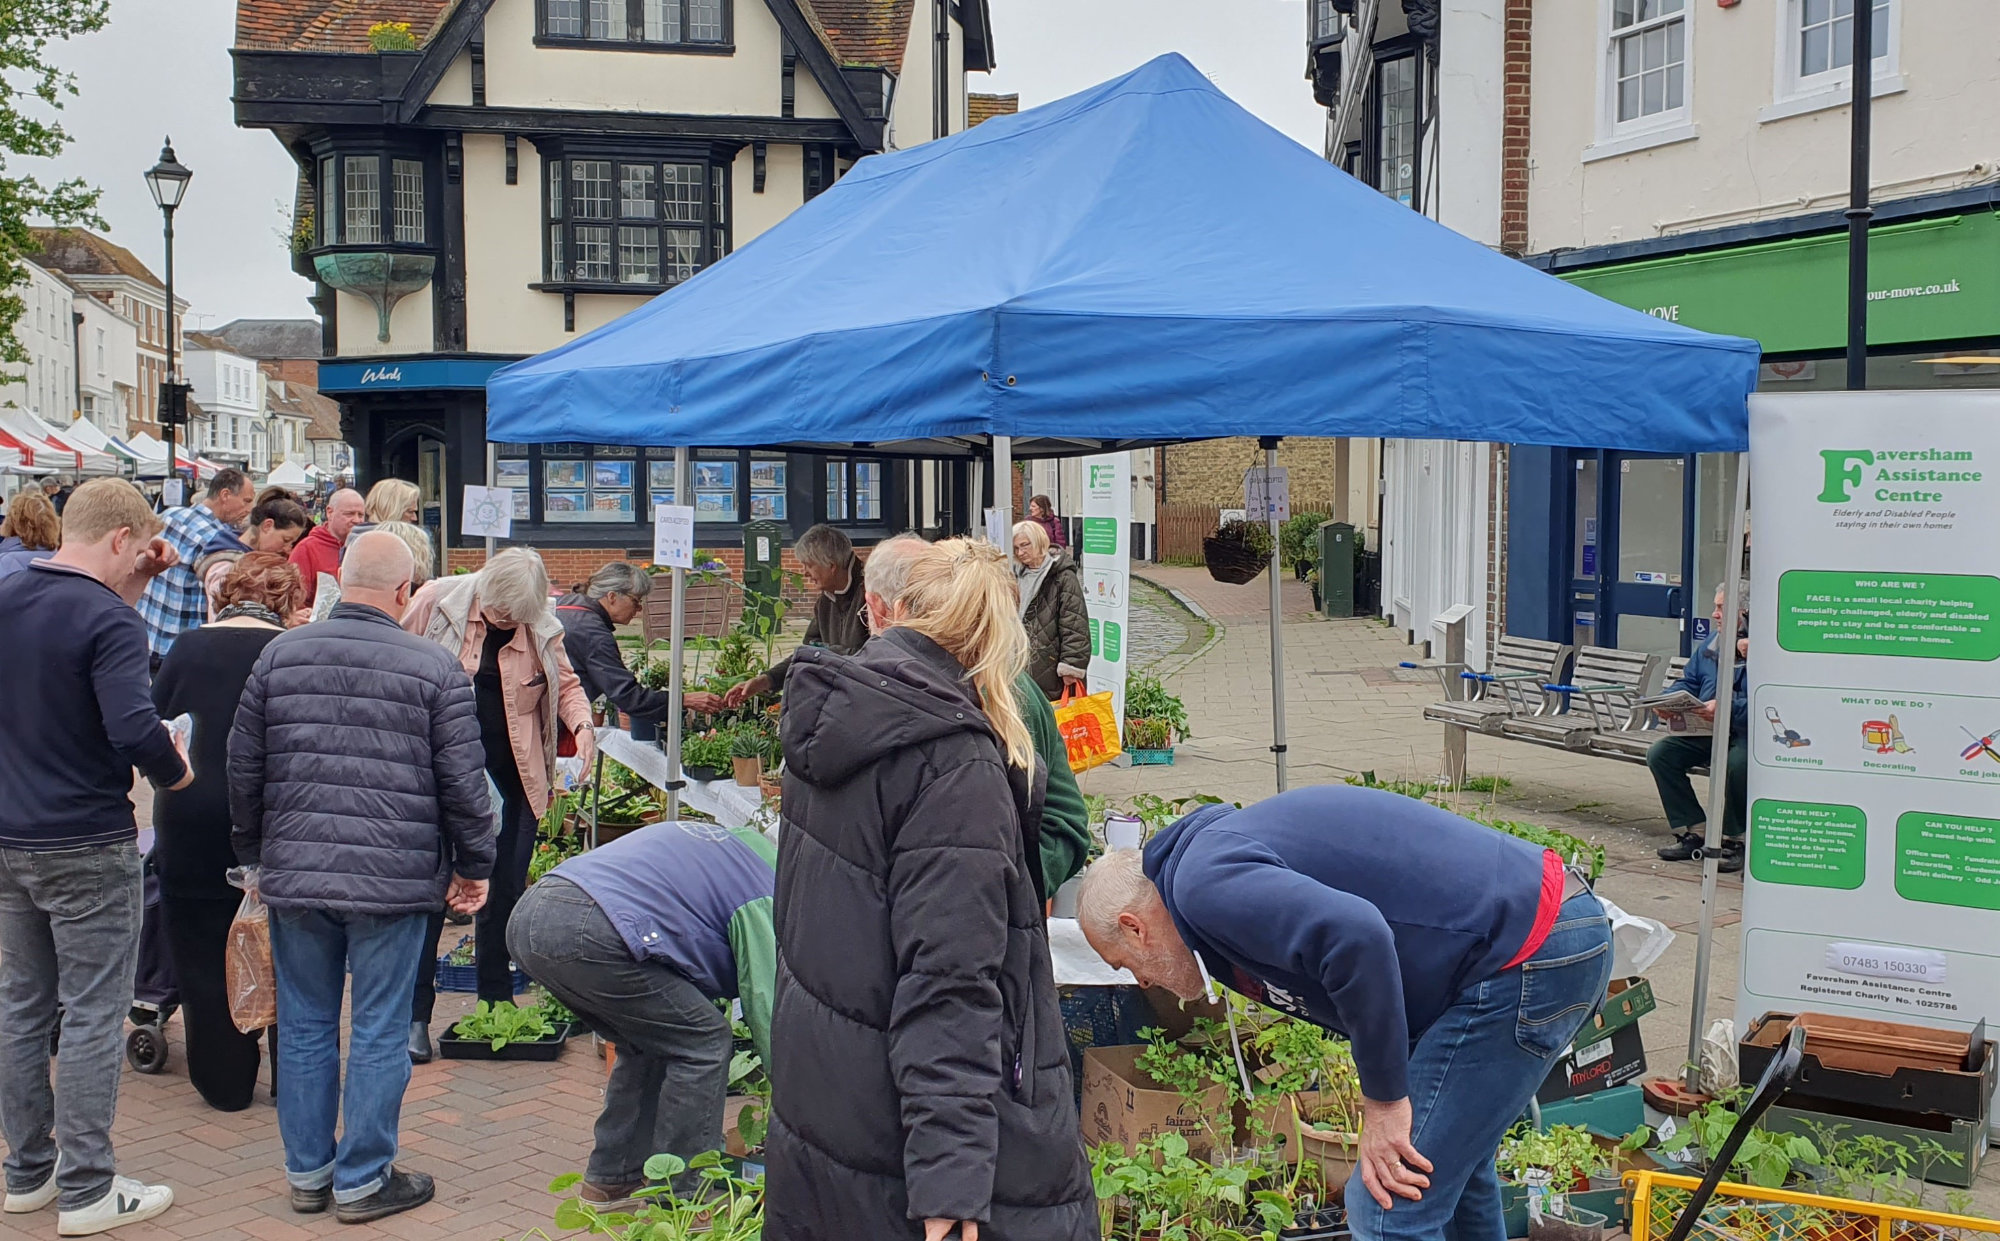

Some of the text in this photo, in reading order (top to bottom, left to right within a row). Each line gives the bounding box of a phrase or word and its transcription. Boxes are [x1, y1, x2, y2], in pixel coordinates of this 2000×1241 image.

[1867, 279, 1960, 301] our-move.co.uk
[361, 366, 401, 384] Wards
[1875, 468, 1982, 481] Assistance
[1875, 488, 1942, 502] Centre
[1832, 508, 1956, 520] Elderly and Disabled People
[1835, 521, 1867, 530] staying
[1923, 522, 1953, 530] homes
[1905, 598, 1938, 607] charity
[1940, 600, 1974, 608] helping
[1792, 606, 1838, 616] financially
[1840, 608, 1893, 618] challenged,
[1896, 610, 1927, 619] elderly
[1842, 621, 1862, 629] stay
[1912, 624, 1967, 632] comfortable
[1920, 636, 1954, 644] homes.
[1775, 755, 1823, 766] Gardening
[1863, 761, 1916, 772] Decorating
[1982, 770, 2000, 778] job
[1786, 818, 1812, 827] elderly
[1768, 825, 1798, 833] benefits
[1826, 830, 1856, 838] income,
[1905, 849, 1928, 857] Office
[1770, 859, 1795, 867] Please
[1910, 860, 1953, 871] Decorating
[1903, 868, 1930, 877] Leaflet
[1932, 872, 1963, 882] delivery
[1843, 956, 1927, 974] 07483 150330
[1806, 973, 1952, 998] Faversham Assistance Centre
[1800, 984, 1957, 1010] Registered Charity No. 1025786
[1572, 1060, 1612, 1086] MYLORD
[1179, 1128, 1202, 1136] arm
